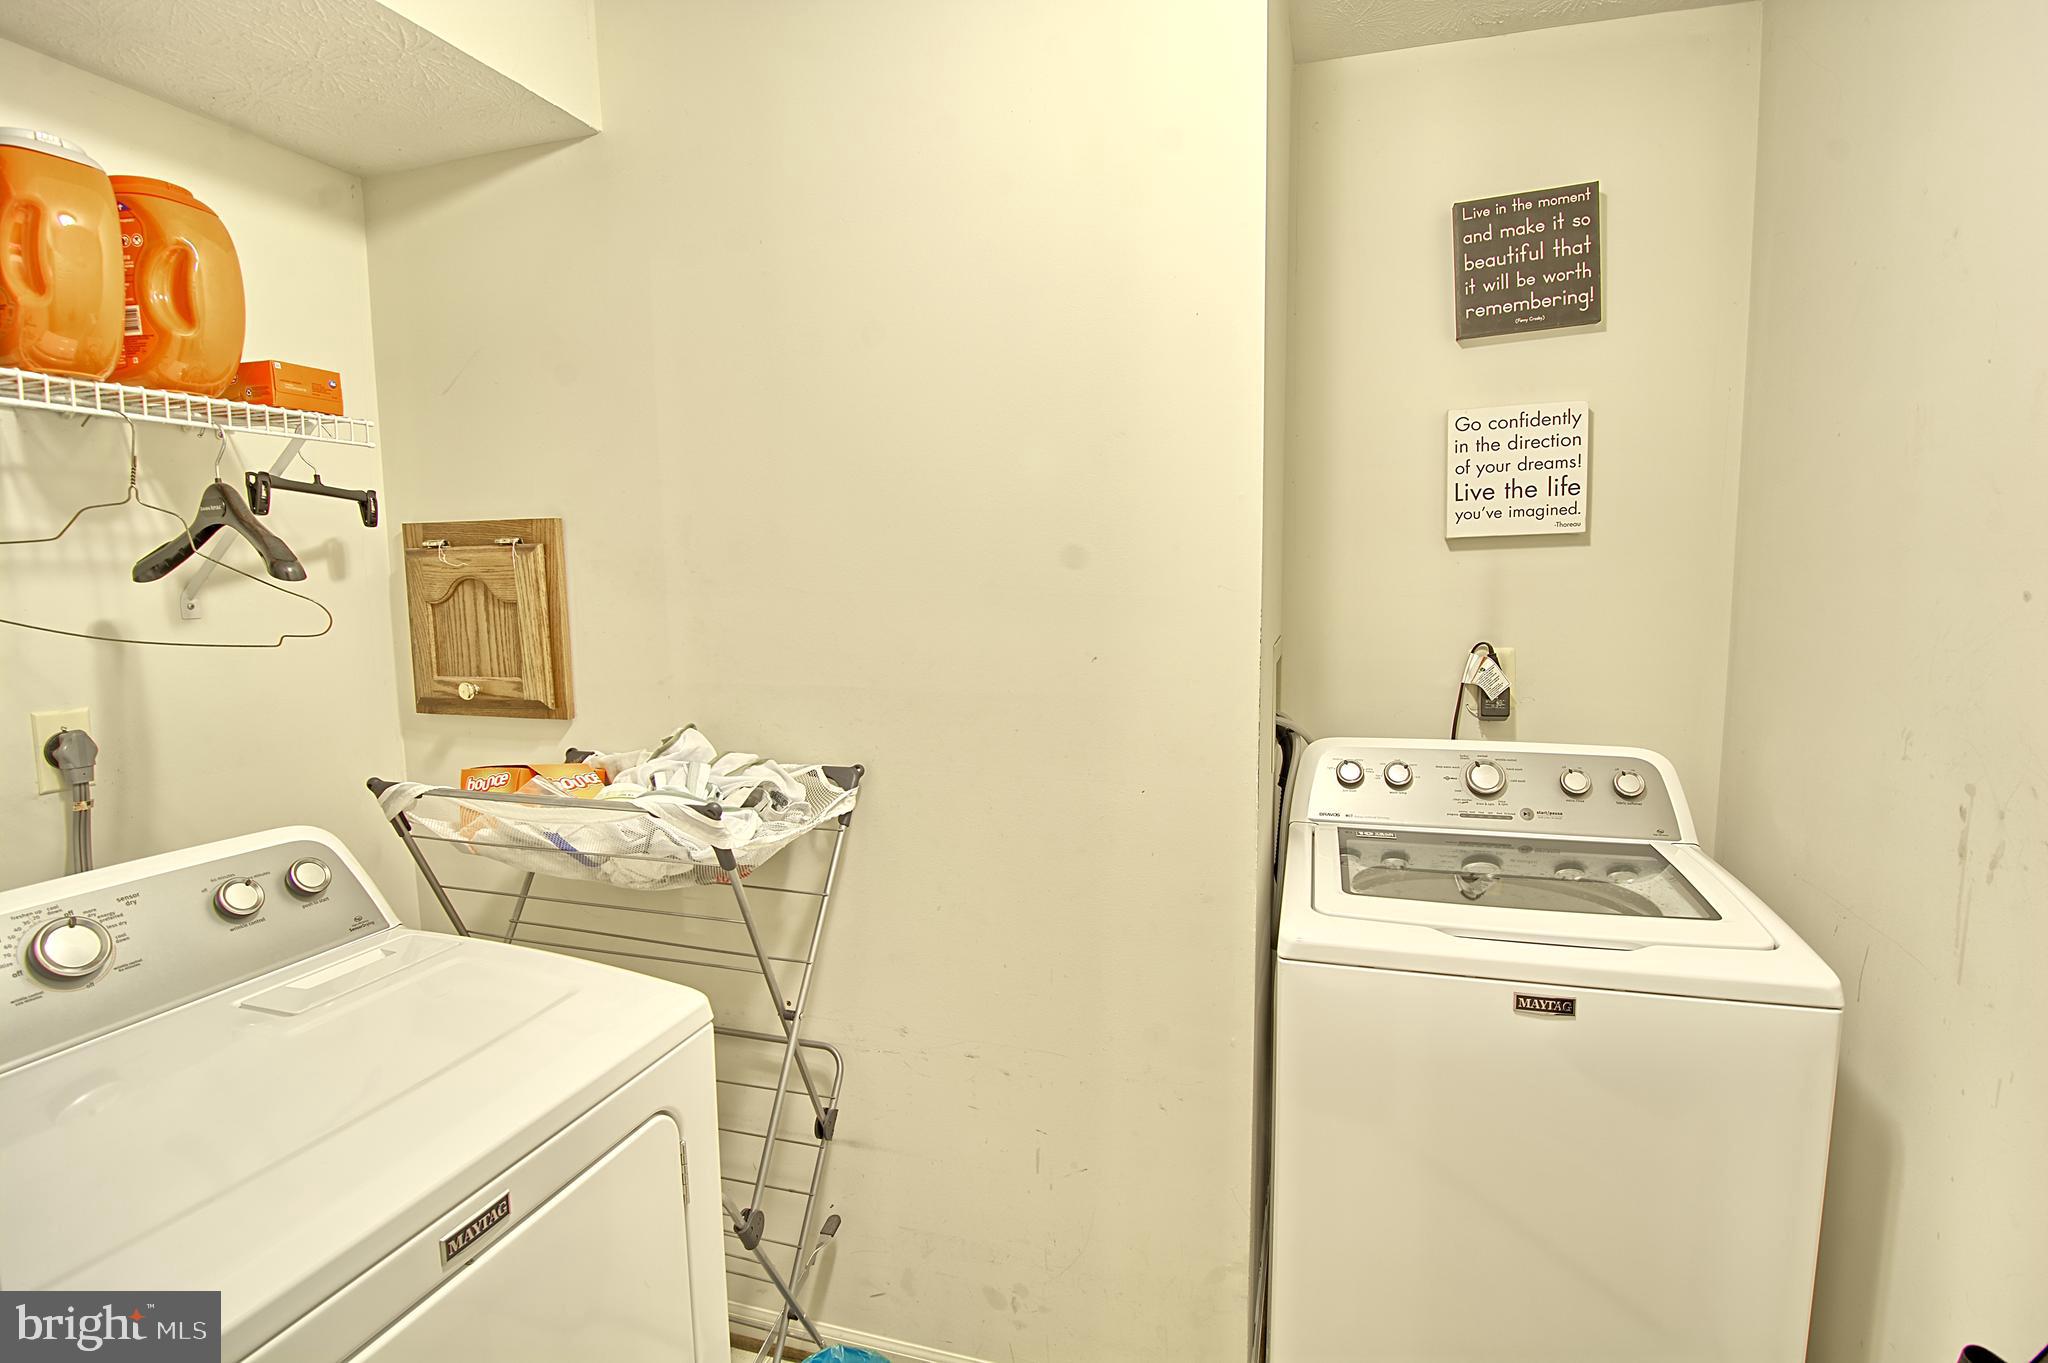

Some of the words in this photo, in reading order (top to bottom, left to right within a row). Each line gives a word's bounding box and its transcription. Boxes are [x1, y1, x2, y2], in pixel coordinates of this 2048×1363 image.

[1462, 207, 1490, 221] Live
[1495, 203, 1507, 215] in
[1511, 198, 1533, 212] the
[1538, 187, 1591, 208] moment
[1463, 223, 1492, 245] and
[1500, 217, 1545, 239] make
[1552, 212, 1564, 230] it
[1572, 215, 1591, 227] so
[1464, 240, 1544, 271] beautiful
[1552, 234, 1591, 257] that
[1464, 278, 1476, 295] it
[1482, 272, 1509, 292] will
[1516, 271, 1536, 287] be
[1542, 261, 1592, 284] worth
[1465, 286, 1594, 319] remembering!
[1455, 416, 1481, 432] Go
[1488, 408, 1582, 430] confidently
[1454, 440, 1468, 453] in
[1476, 436, 1500, 452] the
[1507, 433, 1582, 450] direction
[1455, 459, 1470, 475] of
[1476, 462, 1511, 478] your
[1517, 453, 1581, 472] dreams!
[1455, 482, 1495, 502] Live
[1504, 478, 1538, 499] the
[1547, 475, 1581, 497] life
[1455, 506, 1503, 524] you've
[1508, 501, 1581, 520] imagined.
[467, 771, 511, 791] bounce
[115, 892, 141, 902] sensor
[12, 969, 24, 978] off
[1518, 997, 1573, 1012] MAYTAG
[448, 1200, 508, 1256] MAYTAG
